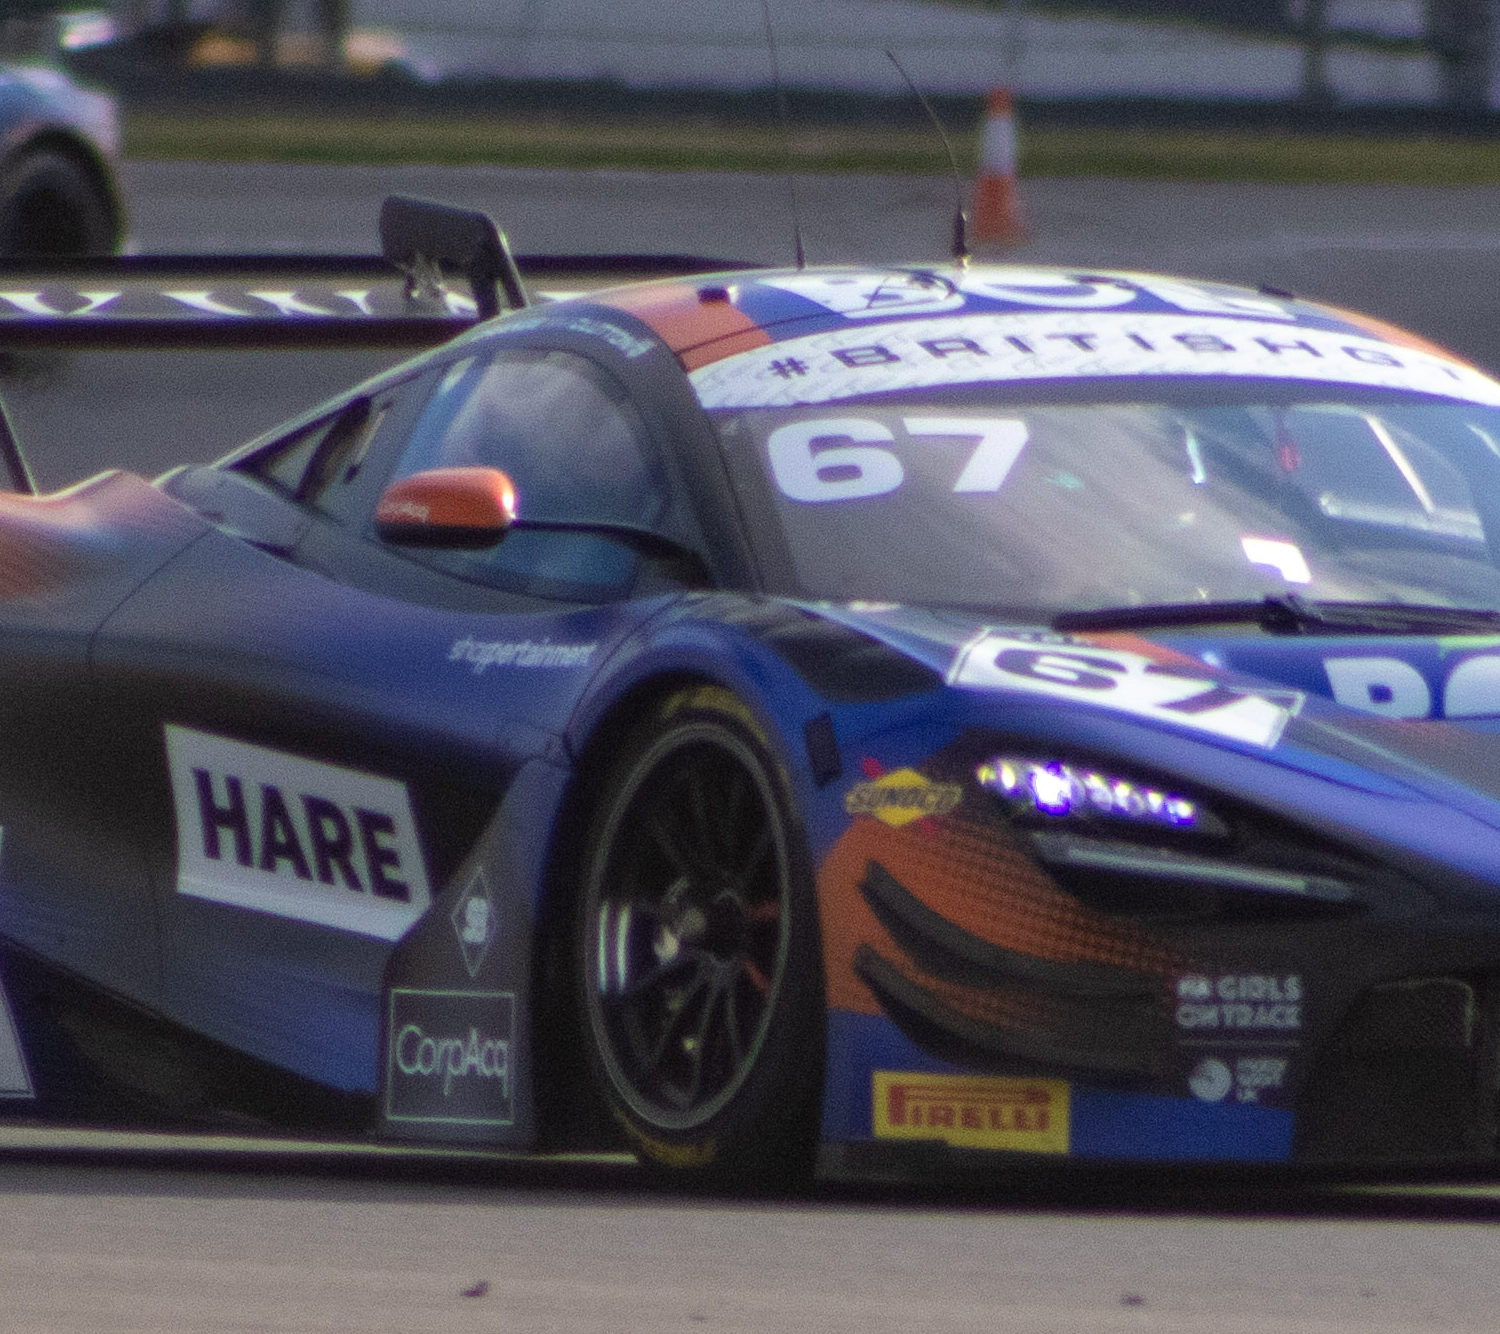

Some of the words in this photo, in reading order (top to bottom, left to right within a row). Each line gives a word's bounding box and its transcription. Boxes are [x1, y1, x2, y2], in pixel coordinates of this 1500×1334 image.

[767, 416, 1030, 503] 67
[994, 647, 1262, 715] 67
[192, 768, 412, 904] HARE
[395, 1023, 509, 1098] CorpAcq
[888, 1083, 1050, 1131] PIRELLI
